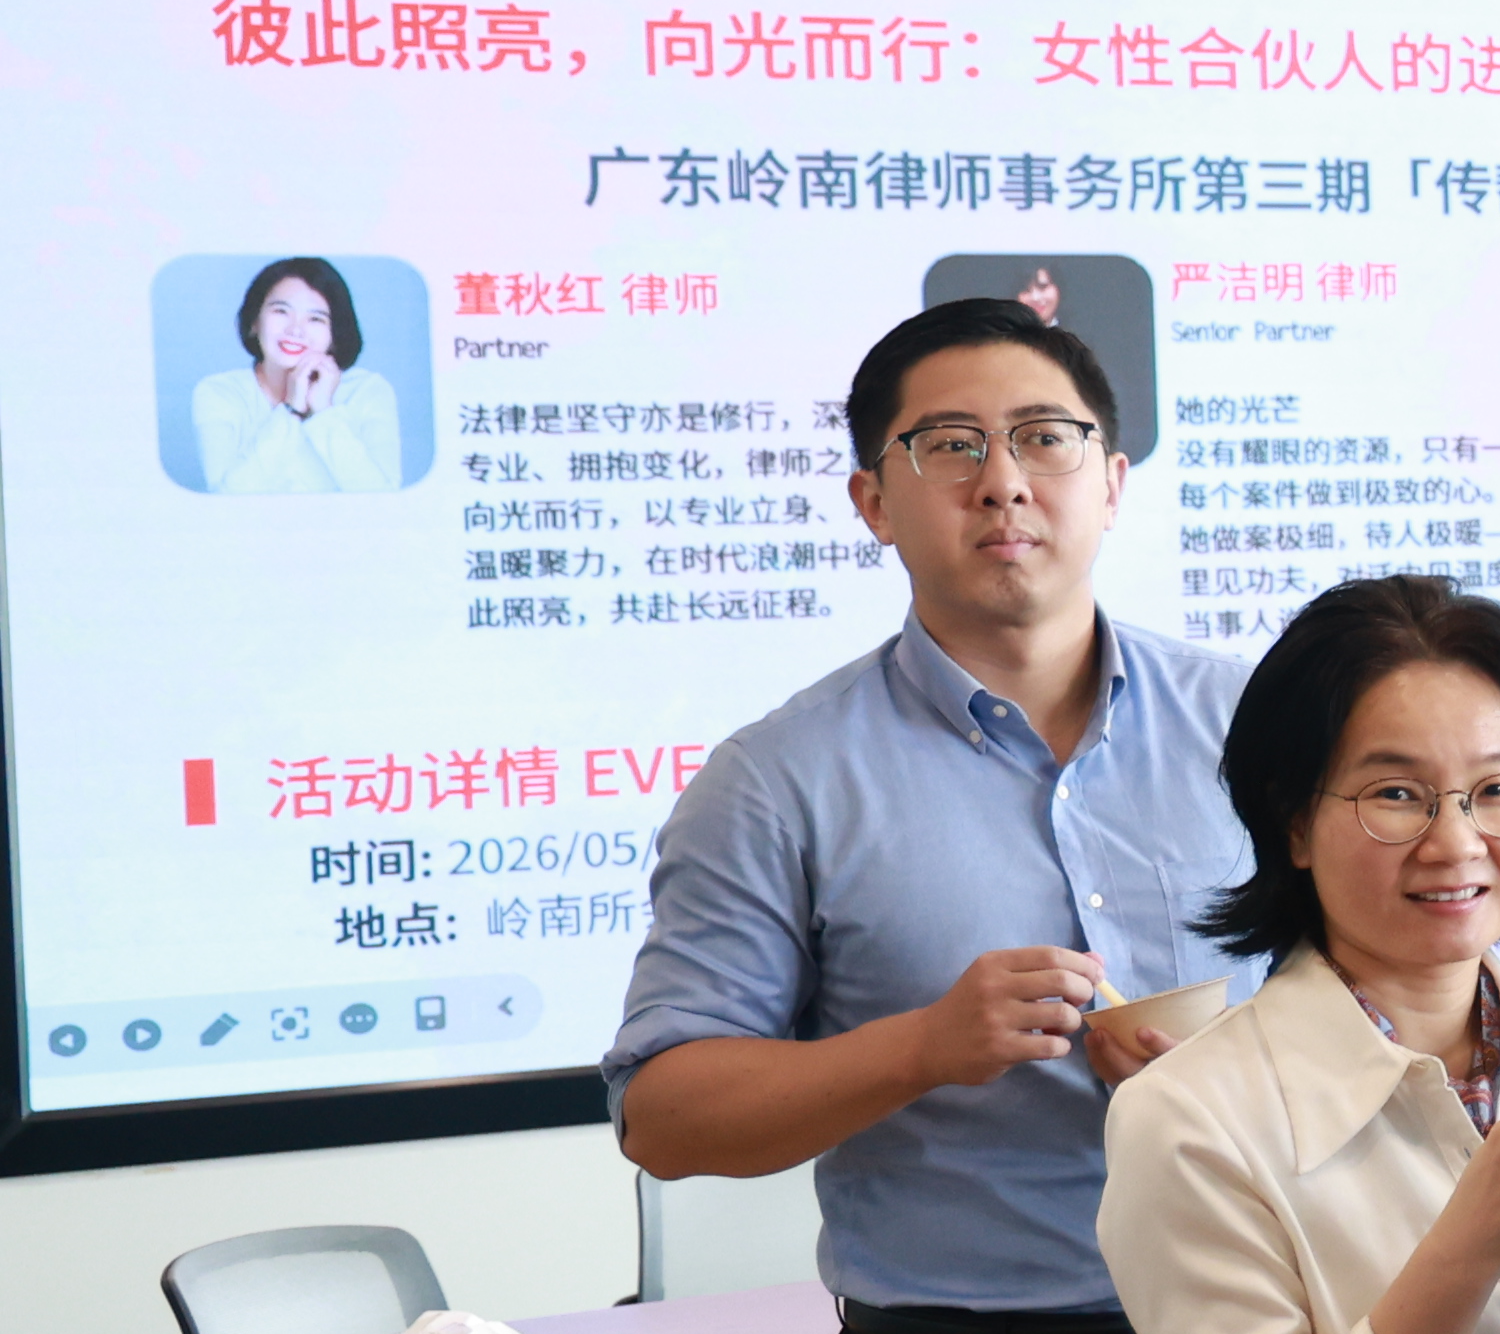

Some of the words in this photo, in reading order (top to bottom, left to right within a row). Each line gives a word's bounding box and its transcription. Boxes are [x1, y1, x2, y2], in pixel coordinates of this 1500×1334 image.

[454, 272, 605, 318] 董秋红
[621, 273, 719, 317] 律师
[1171, 260, 1305, 305] 严洁明
[1317, 261, 1398, 305] 律师
[454, 336, 550, 361] Partner
[1171, 317, 1241, 345] Senior
[1253, 318, 1336, 345] Partner
[459, 400, 850, 435] 法律是坚守亦是修行，深
[1175, 395, 1301, 426] 她的光芒
[1179, 477, 1495, 510] 每个案件做到极致的心。
[464, 495, 863, 533] 向光而行，以专业立身、
[465, 539, 885, 581] 温暖聚力，在时代浪潮中彼
[467, 588, 833, 629] 此照亮，共赴长远征程。
[267, 746, 561, 821] 活动详情
[448, 827, 657, 878] 2026/05/
